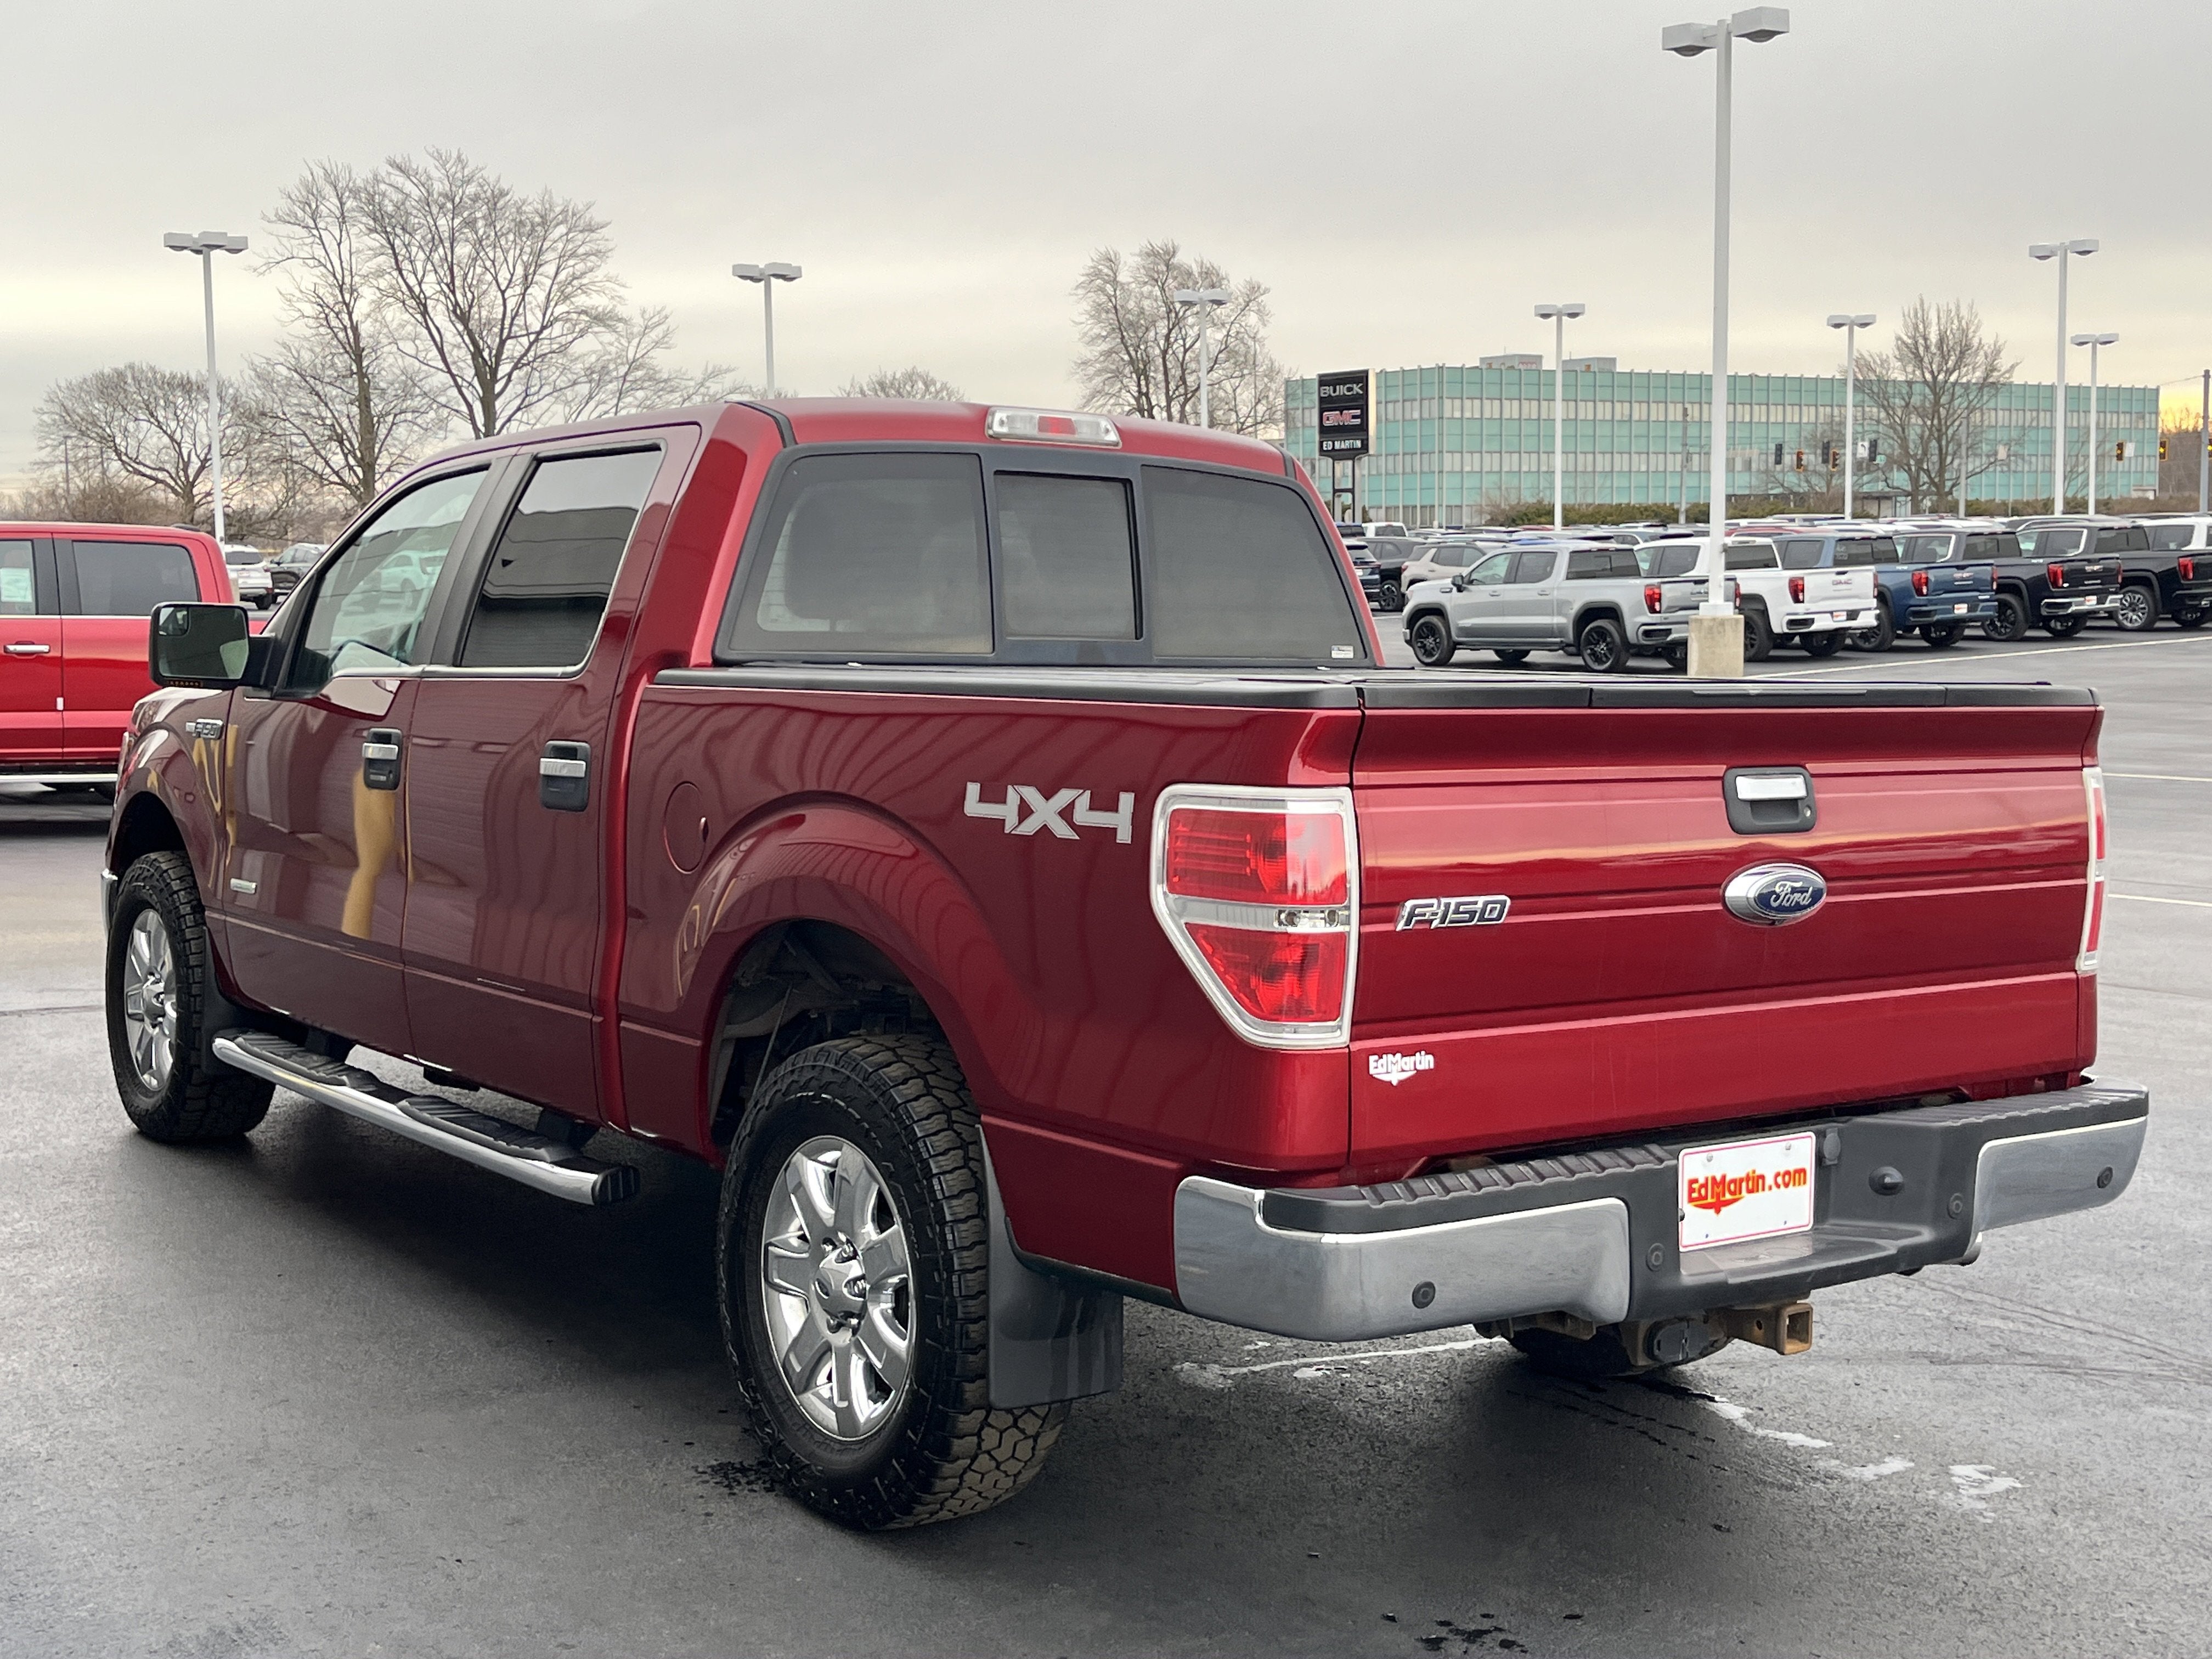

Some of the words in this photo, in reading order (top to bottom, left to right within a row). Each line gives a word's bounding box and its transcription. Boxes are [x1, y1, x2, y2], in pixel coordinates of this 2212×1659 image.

[1320, 383, 1364, 397] BUICK
[1323, 409, 1361, 426] GMC
[1323, 441, 1333, 450] ED
[1334, 439, 1361, 449] MARTIN
[1770, 881, 1813, 907] Ford
